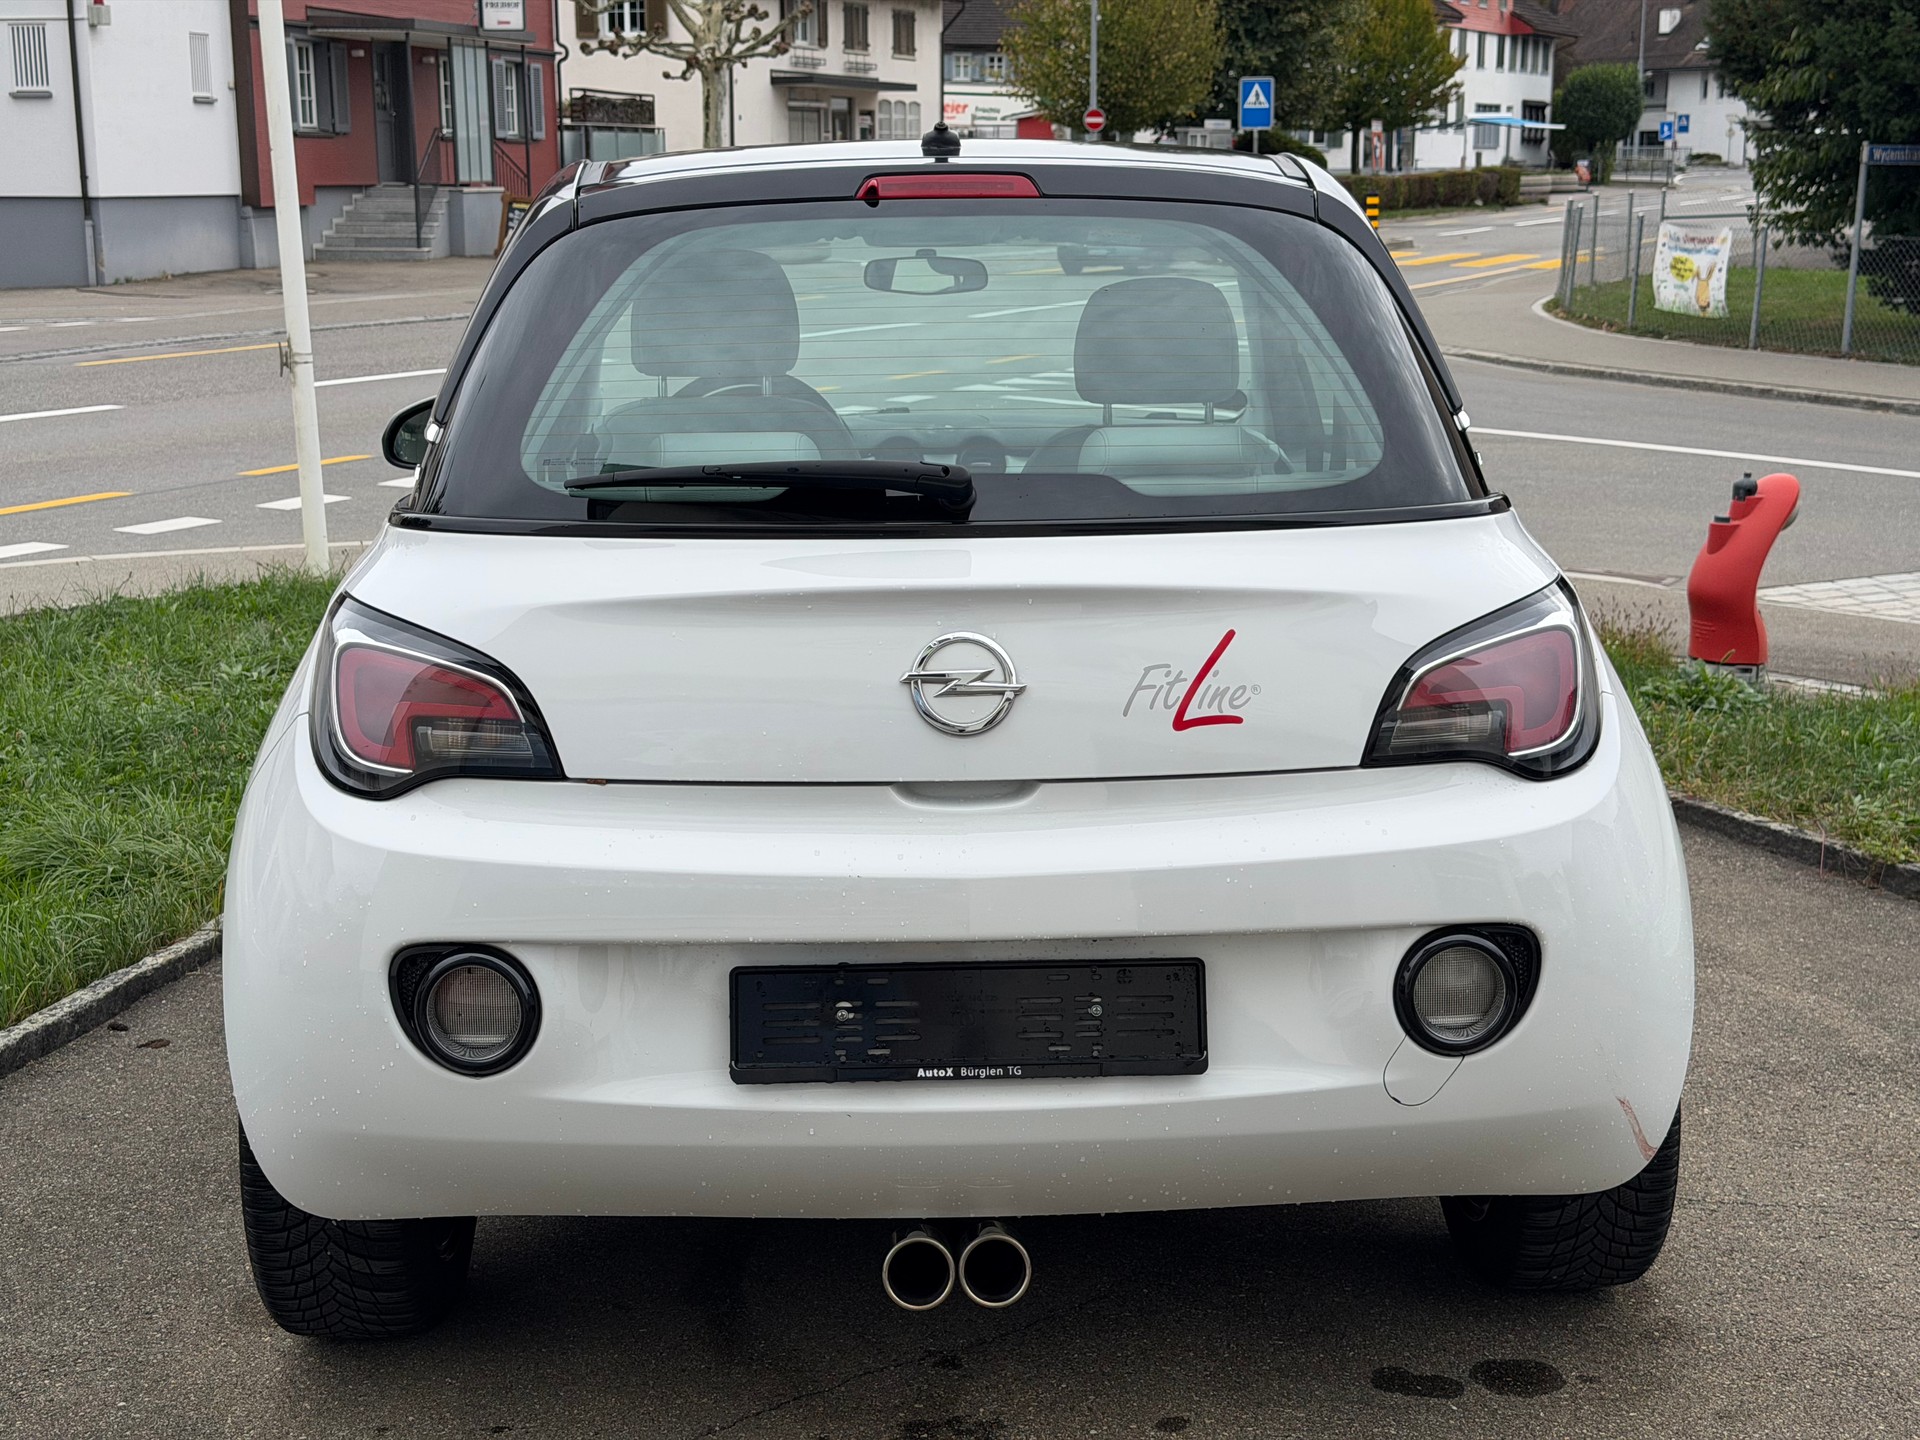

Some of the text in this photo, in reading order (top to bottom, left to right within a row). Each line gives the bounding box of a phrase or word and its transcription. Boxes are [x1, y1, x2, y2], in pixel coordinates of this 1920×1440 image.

[917, 1065, 1022, 1078] AutoX Bürglen TG
